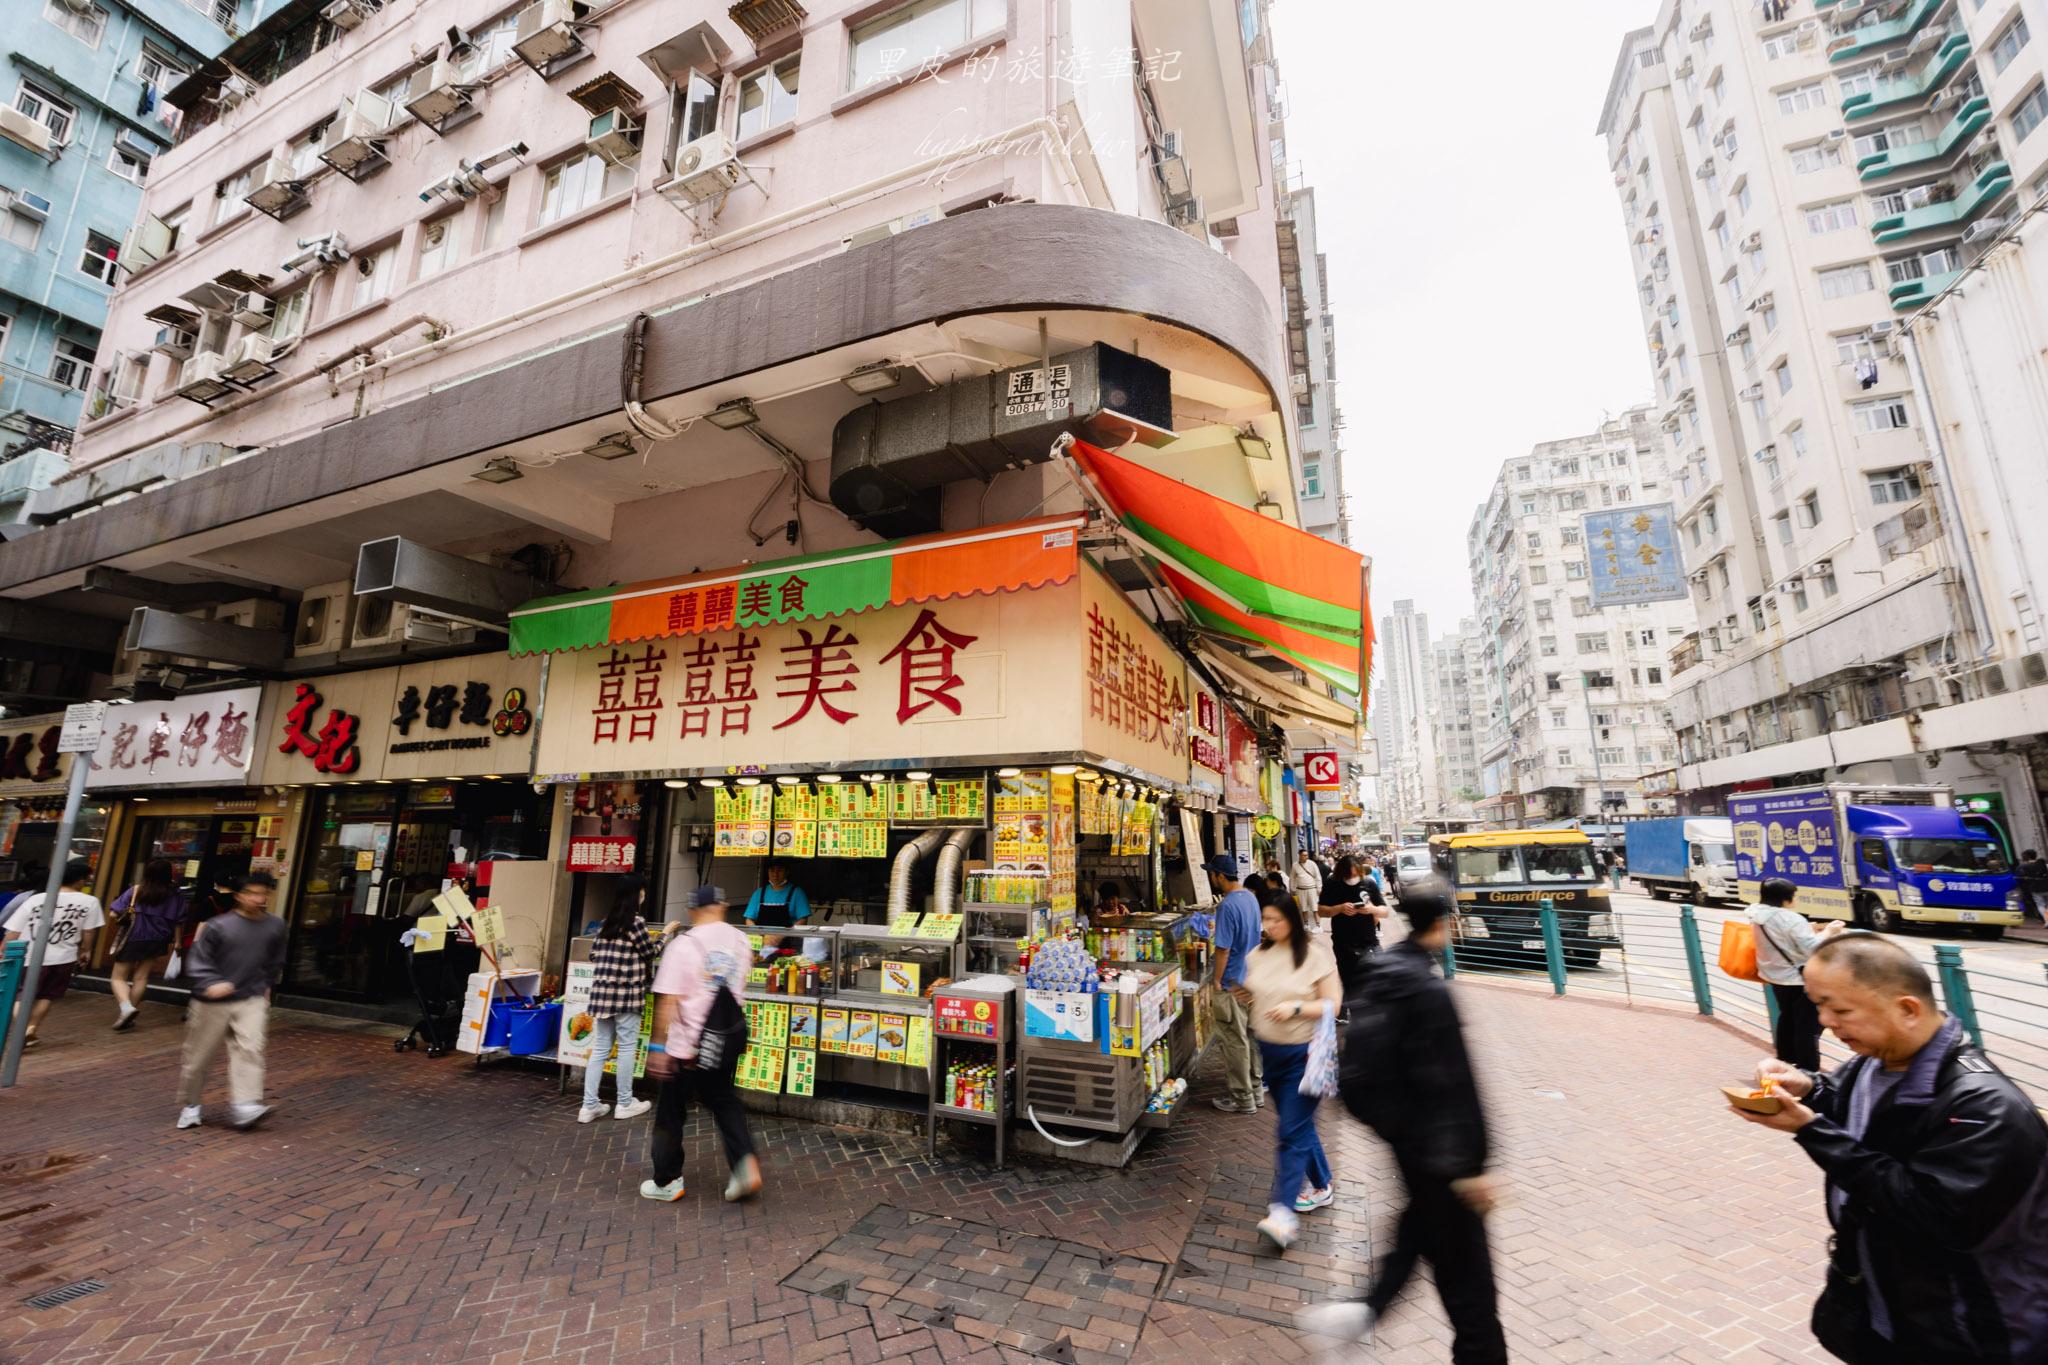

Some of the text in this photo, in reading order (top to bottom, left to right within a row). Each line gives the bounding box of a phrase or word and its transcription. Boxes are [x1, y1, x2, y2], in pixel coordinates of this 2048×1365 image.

[1008, 398, 1066, 415] 9081780
[667, 574, 810, 629] 囍囍美食
[592, 608, 979, 745] 囍囍美食
[1489, 889, 1576, 902] Guardforce
